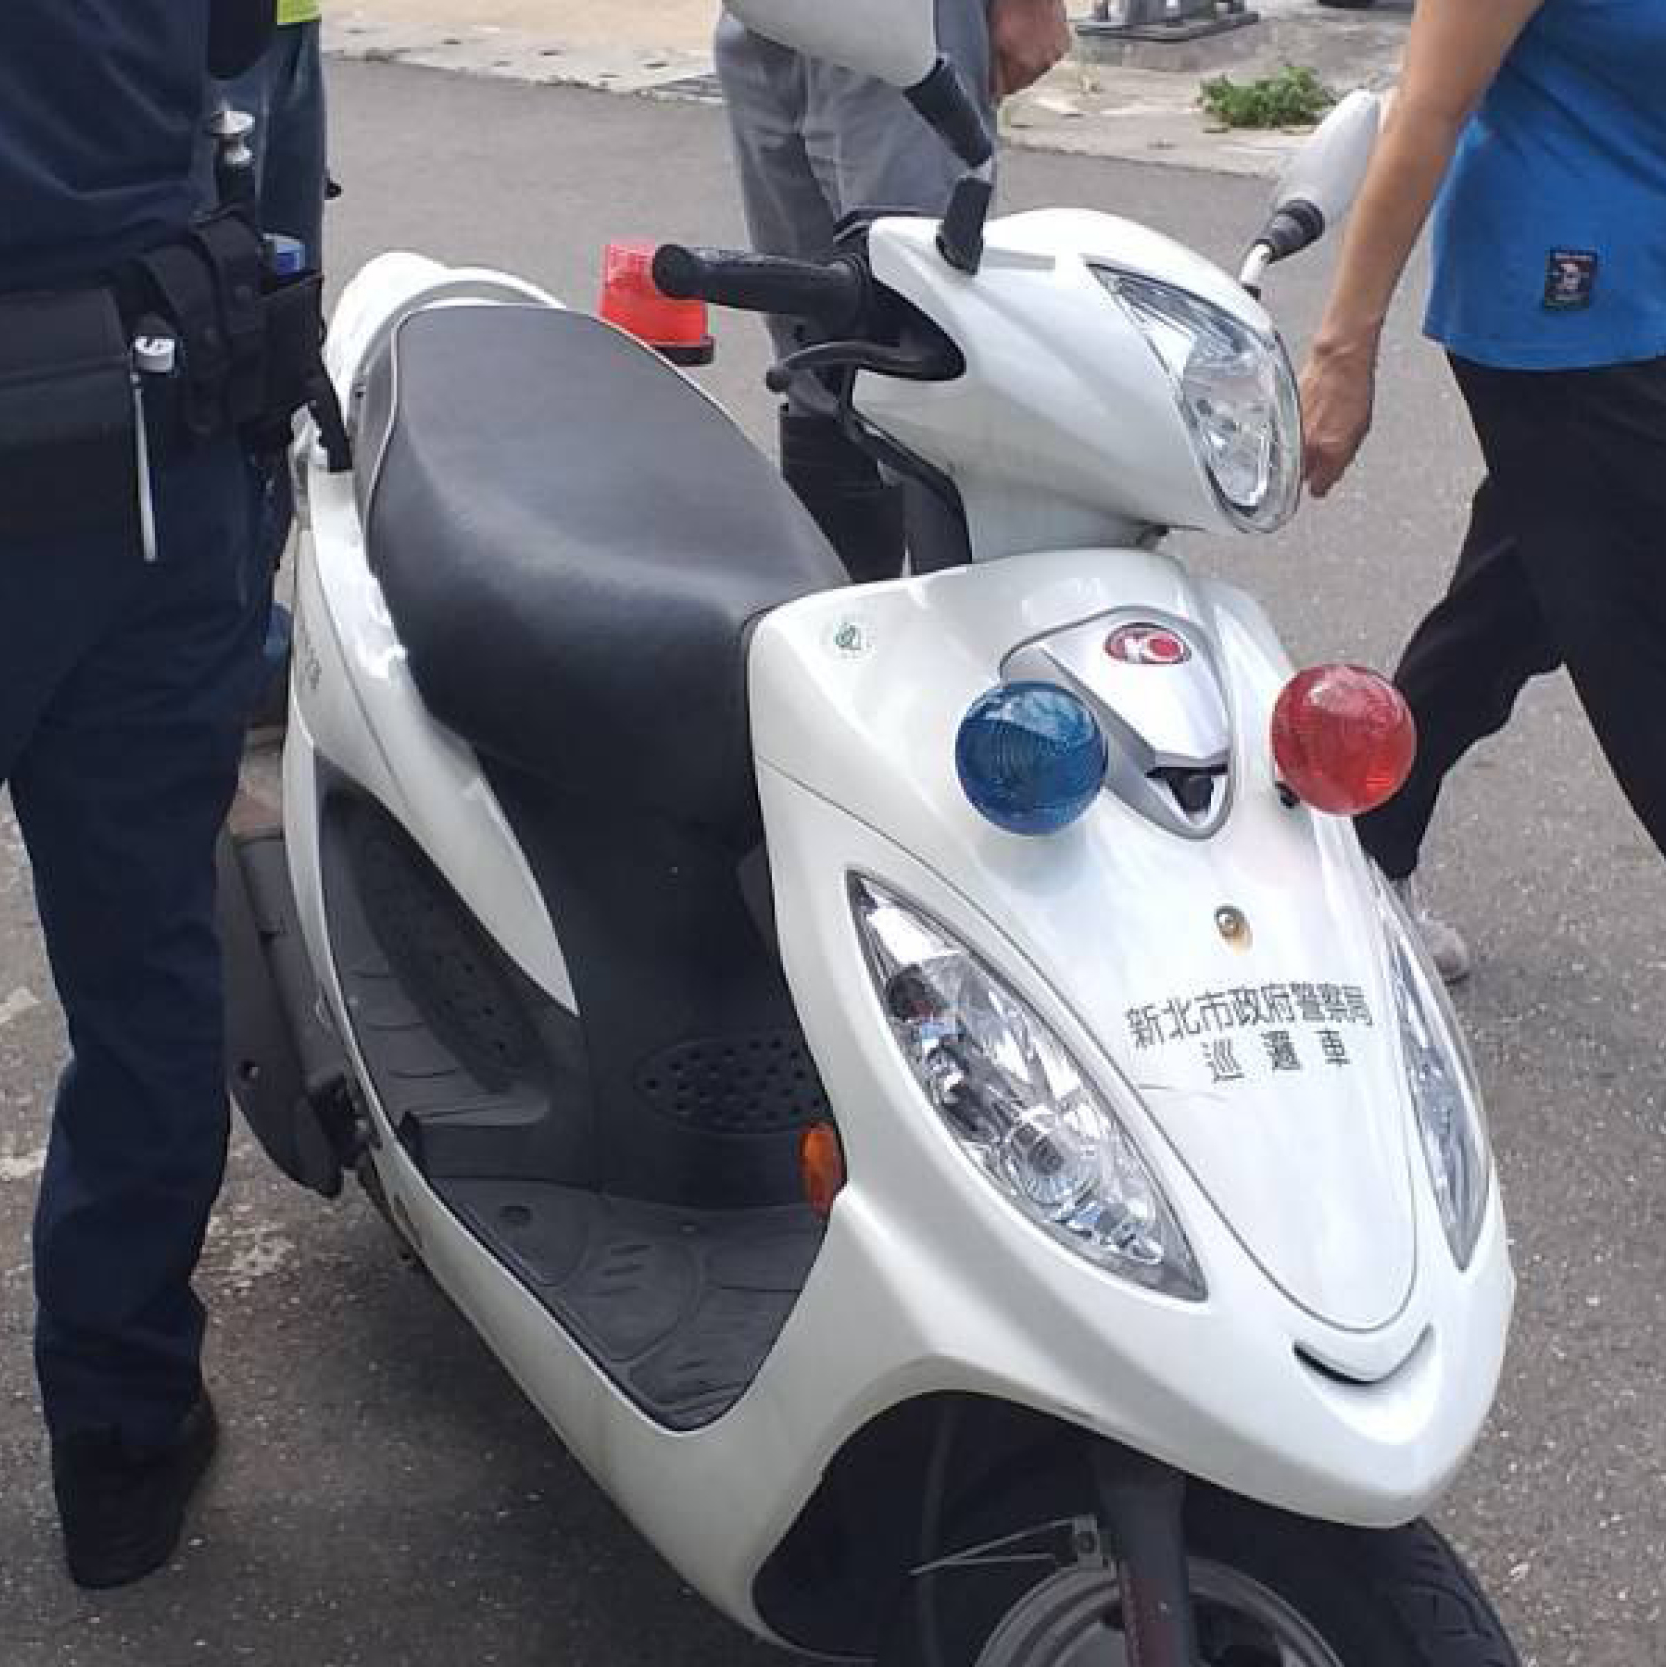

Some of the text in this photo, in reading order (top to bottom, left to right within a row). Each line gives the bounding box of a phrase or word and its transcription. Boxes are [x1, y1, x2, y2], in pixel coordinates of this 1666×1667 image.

[1125, 981, 1374, 1049] 新北市政府警察局
